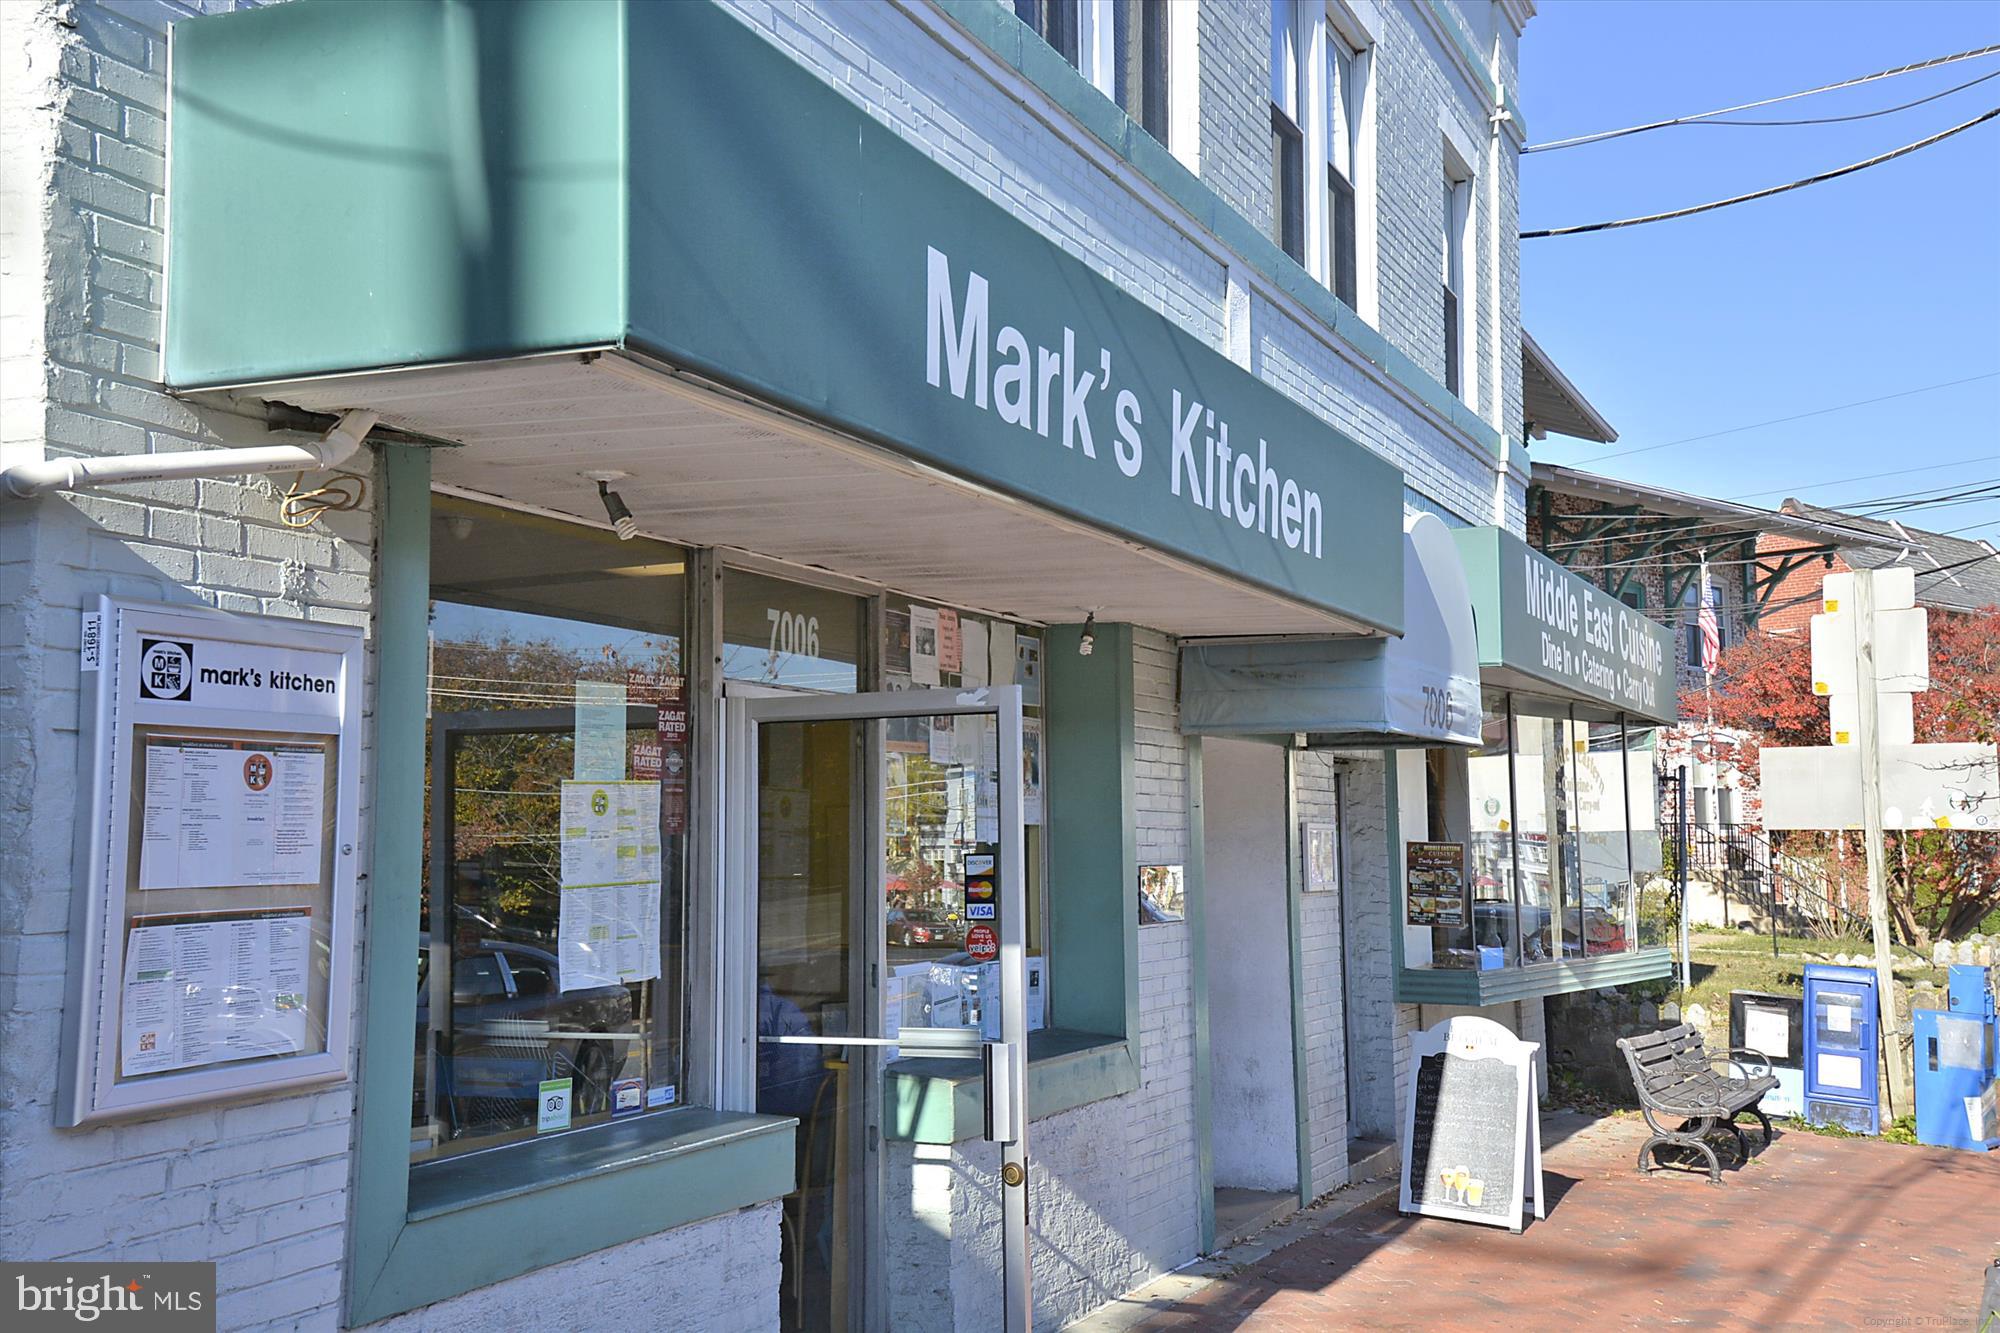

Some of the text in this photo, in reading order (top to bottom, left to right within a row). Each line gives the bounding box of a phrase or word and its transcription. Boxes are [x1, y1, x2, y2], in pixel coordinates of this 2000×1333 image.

[926, 244, 1323, 559] Mark's Kitchen
[1525, 554, 1663, 676] Middle East Cuisine
[86, 620, 97, 662] S-16811
[767, 608, 820, 660] 7006
[1541, 631, 1656, 710] Dine In Catering Carry Out
[200, 665, 336, 694] mark's kitchen
[629, 673, 655, 687] ZAGAT
[659, 674, 685, 687] ZAGAT
[1422, 685, 1454, 730] 7006
[658, 710, 686, 721] ZAGAT
[658, 722, 686, 732] RATED
[633, 744, 662, 755] ZAGAT
[633, 757, 662, 768] RATED
[969, 906, 993, 916] VISA
[968, 943, 988, 955] yelp
